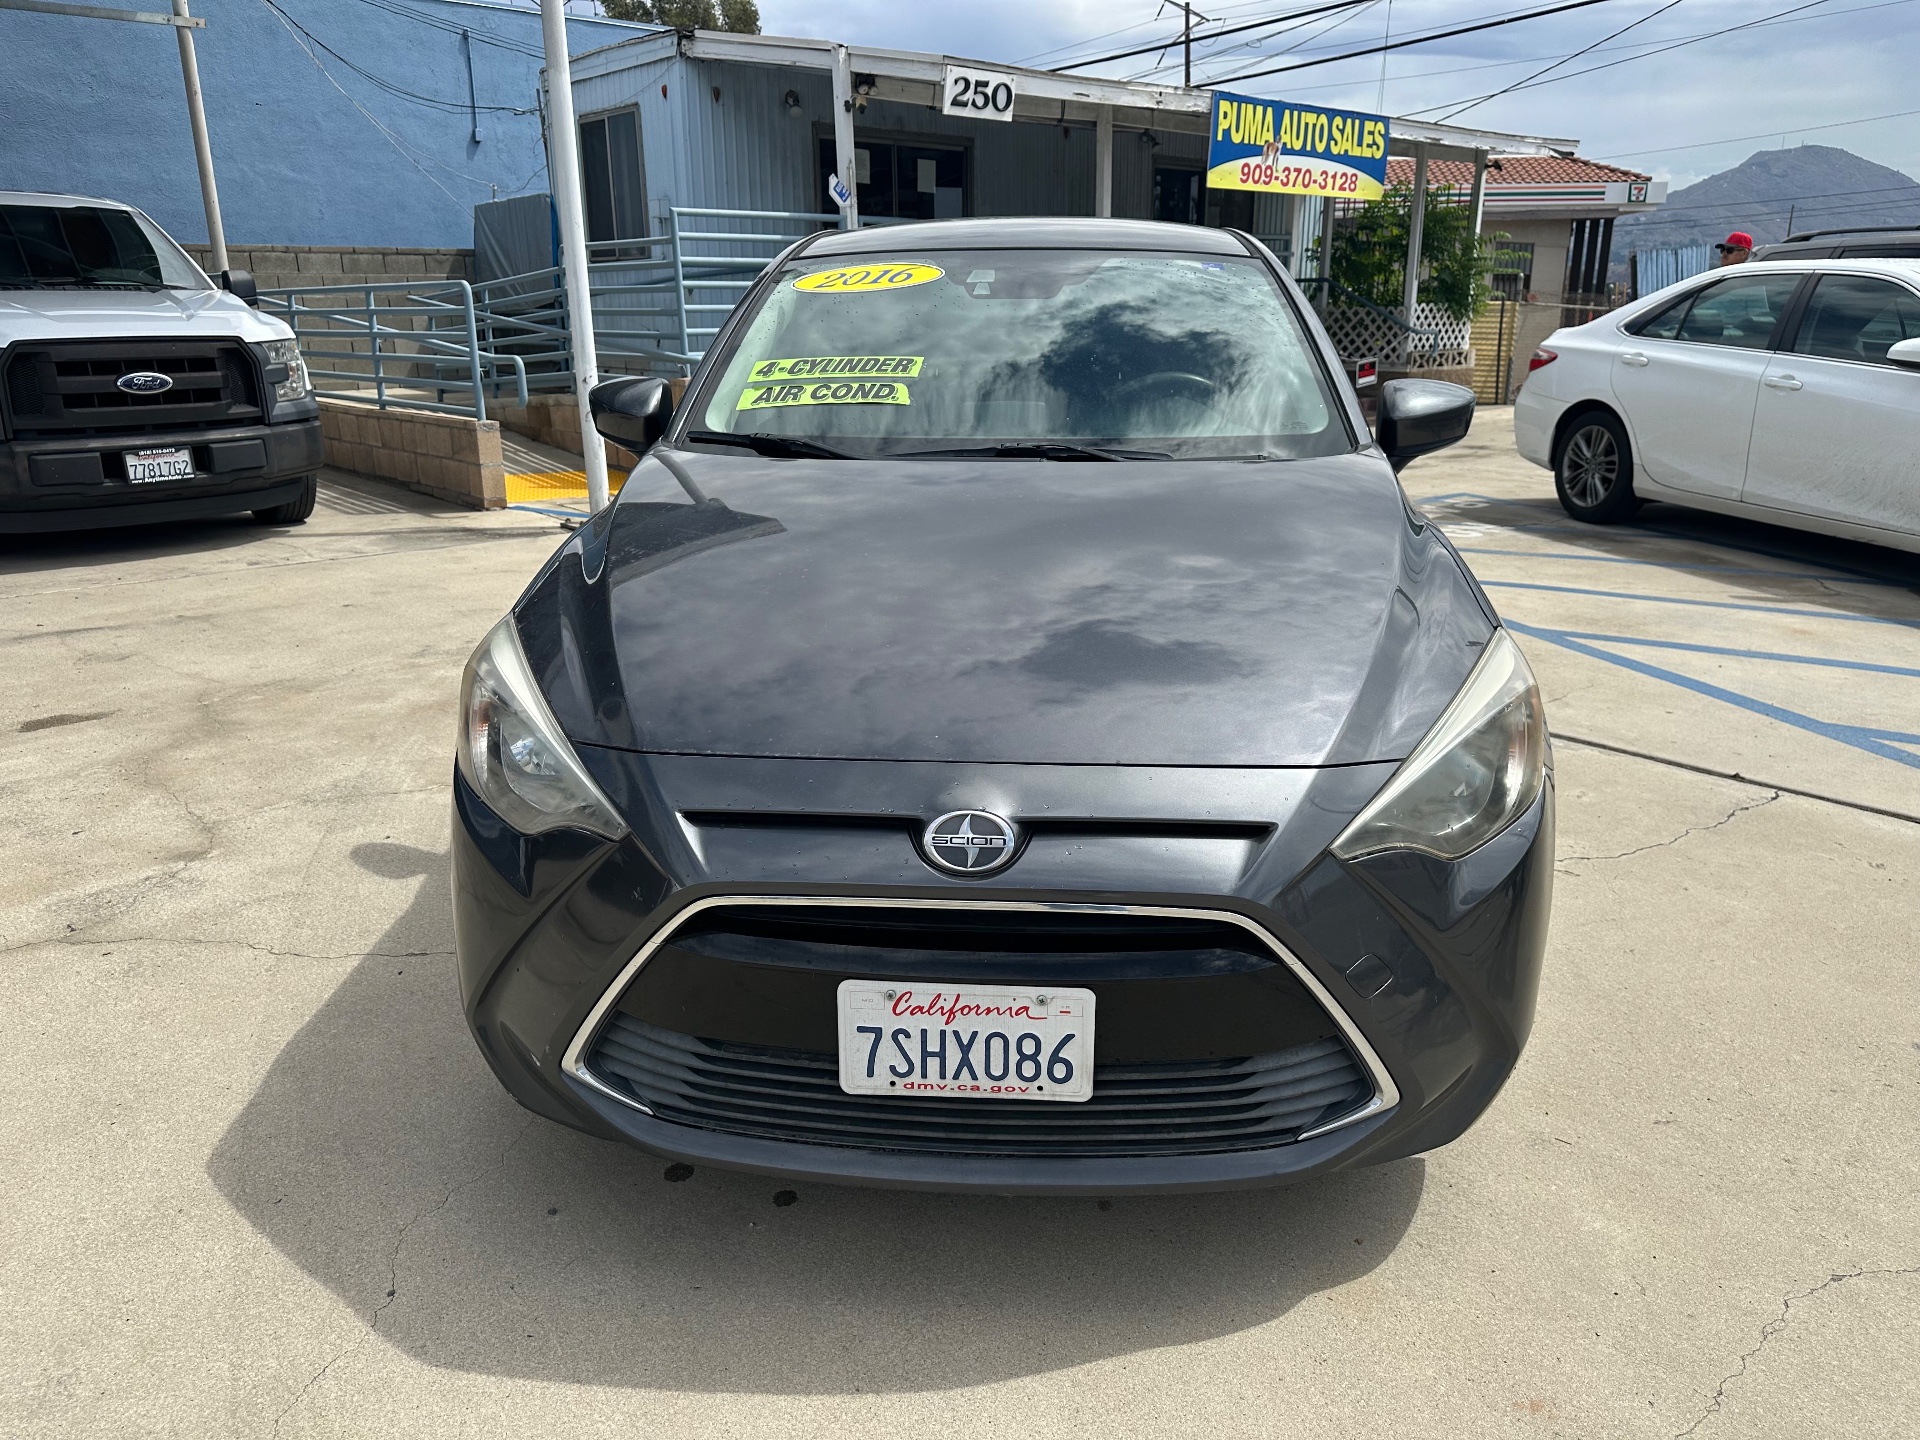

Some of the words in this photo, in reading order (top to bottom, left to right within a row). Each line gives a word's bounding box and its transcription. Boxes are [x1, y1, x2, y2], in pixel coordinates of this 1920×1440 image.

[950, 76, 1013, 112] 250
[1216, 99, 1275, 146] PUMA
[1279, 109, 1329, 153] AUTO
[1330, 115, 1386, 159] SALES
[1239, 162, 1359, 193] 909-370-3128
[813, 267, 921, 289] 2016
[755, 357, 918, 377] 4-CYLINDER
[131, 376, 160, 389] Ford
[752, 385, 806, 406] AIR
[810, 383, 900, 402] COND.
[129, 460, 193, 480] 77817G2
[931, 835, 1007, 846] SCION
[891, 990, 1048, 1025] California
[856, 1025, 1076, 1084] 7SHX086
[903, 1081, 1030, 1093] dmv.ca.gov
